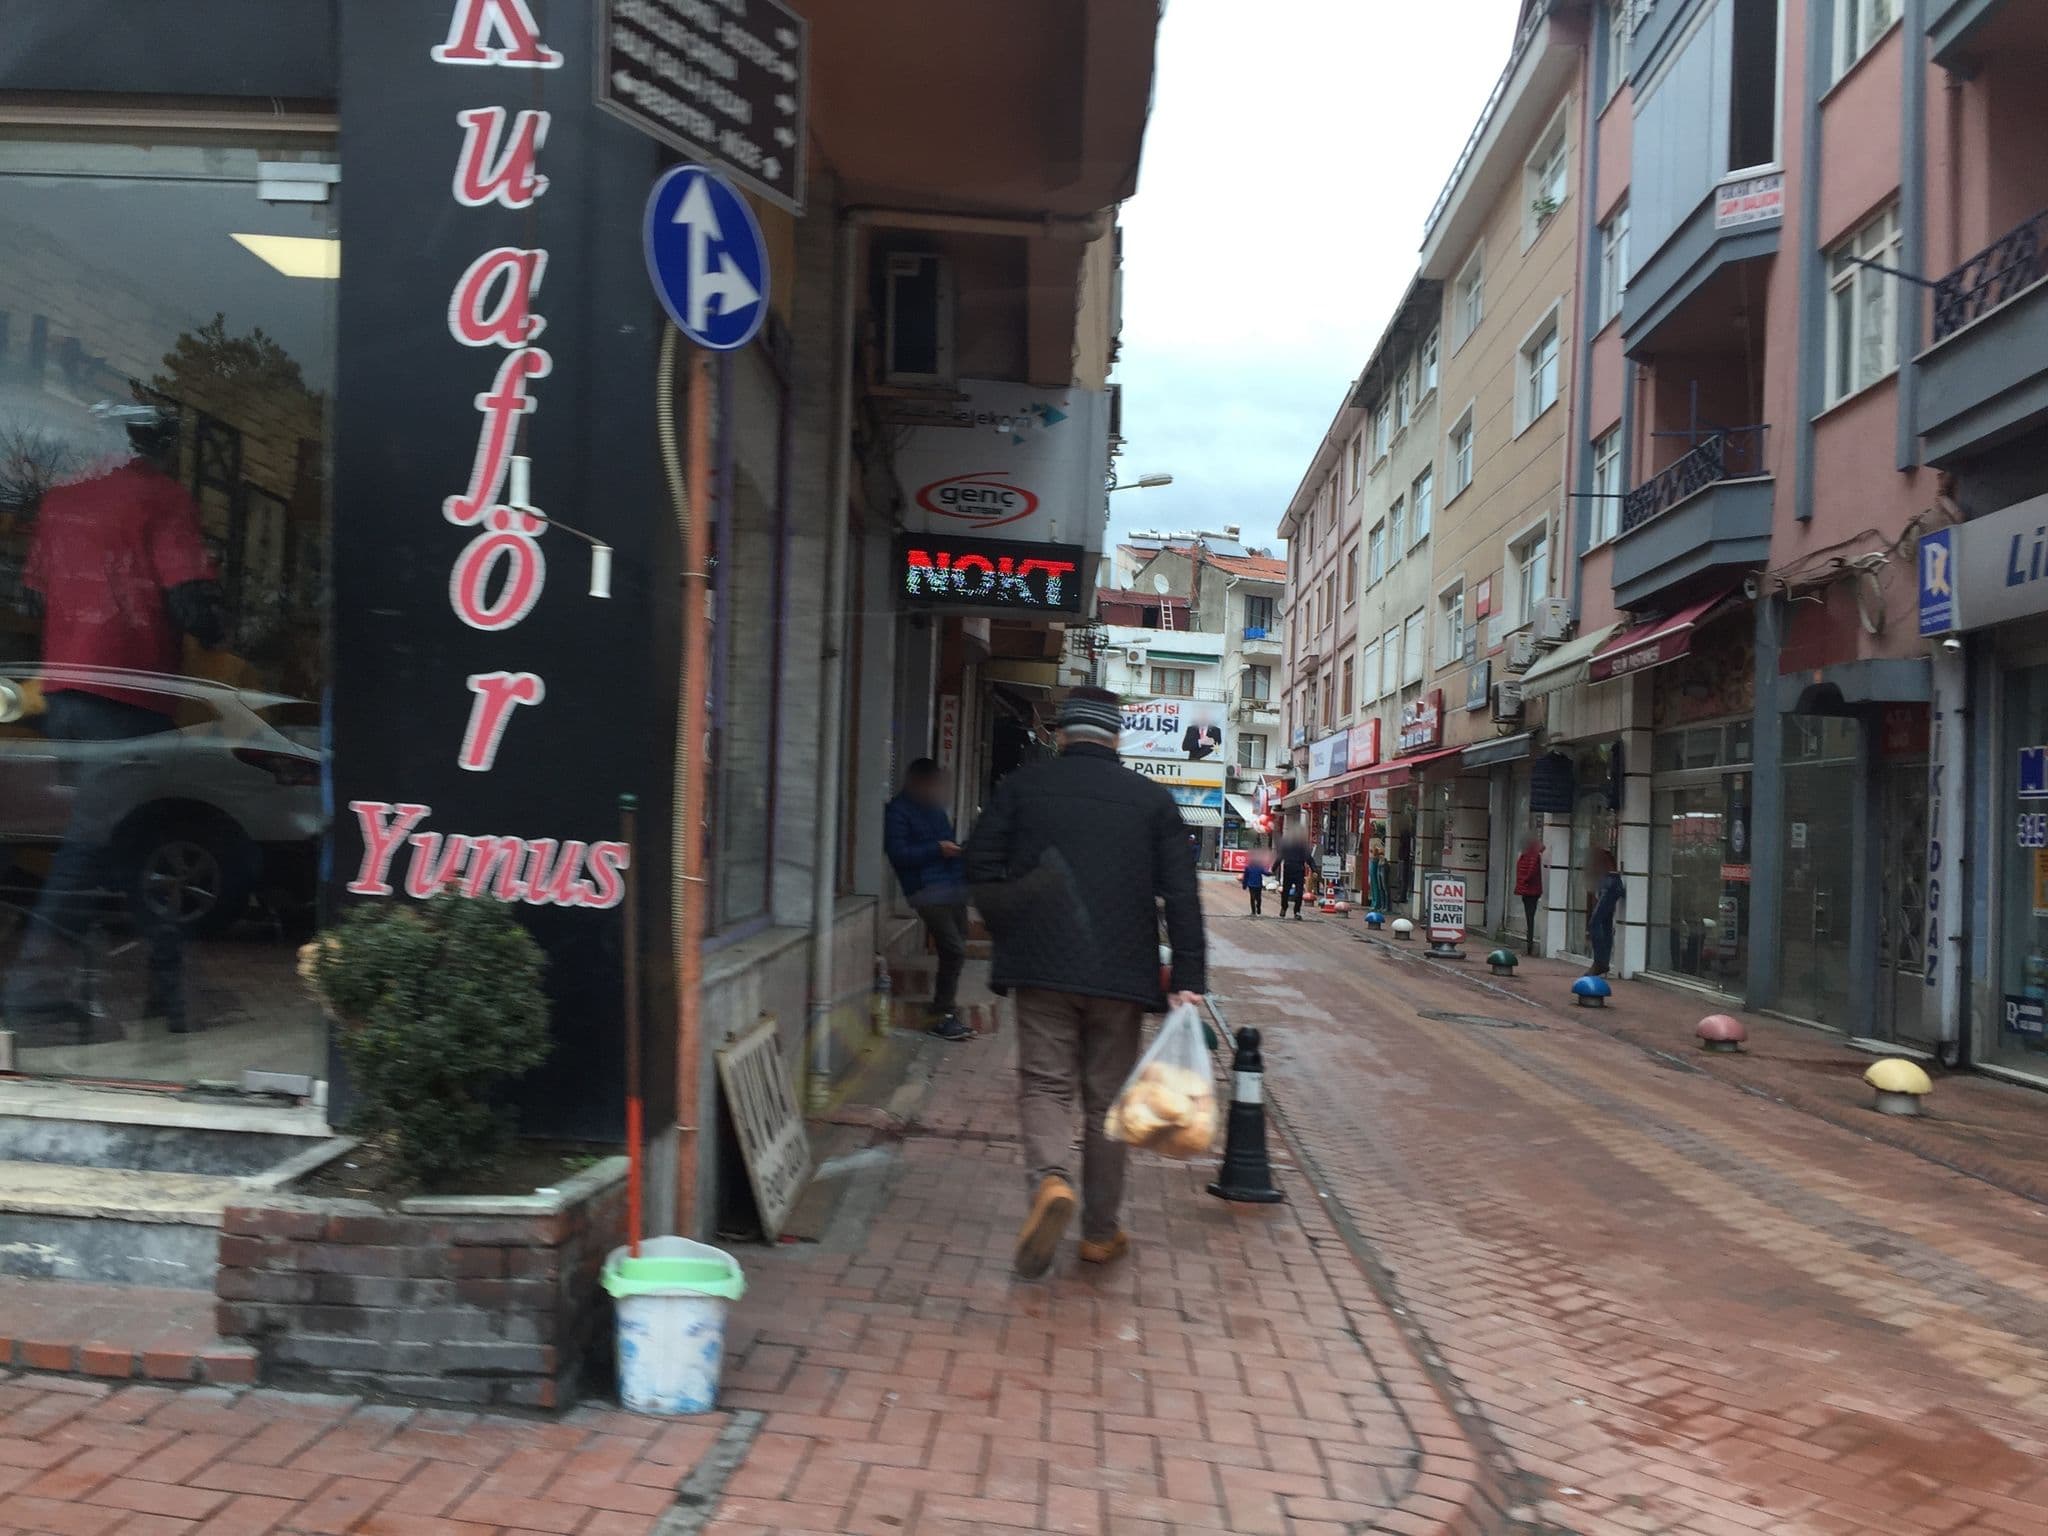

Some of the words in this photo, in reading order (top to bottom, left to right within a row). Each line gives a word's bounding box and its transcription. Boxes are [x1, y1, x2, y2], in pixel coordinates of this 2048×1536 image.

[940, 487, 1015, 507] genç
[2005, 526, 2048, 588] Li
[906, 550, 1076, 605] NOKT
[1119, 713, 1153, 731] NÜL
[1155, 714, 1179, 735] İŞİ
[347, 801, 630, 909] Yunus
[1433, 884, 1463, 897] CAN
